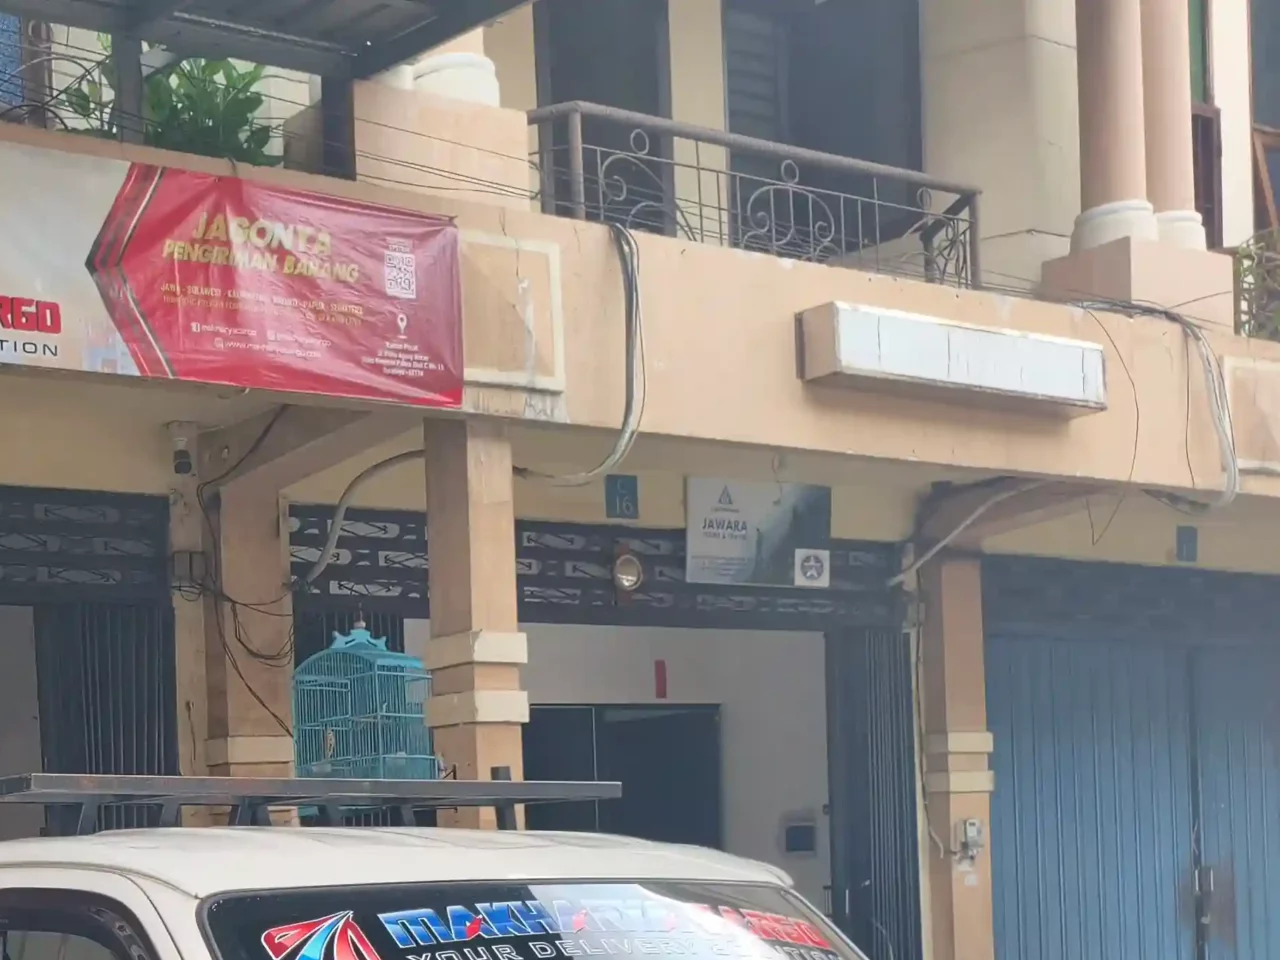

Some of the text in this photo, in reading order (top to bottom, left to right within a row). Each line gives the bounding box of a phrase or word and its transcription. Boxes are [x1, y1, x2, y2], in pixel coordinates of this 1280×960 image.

[616, 495, 633, 516] 16
[702, 517, 748, 533] JAWARA
[528, 938, 697, 959] DELIVERY
